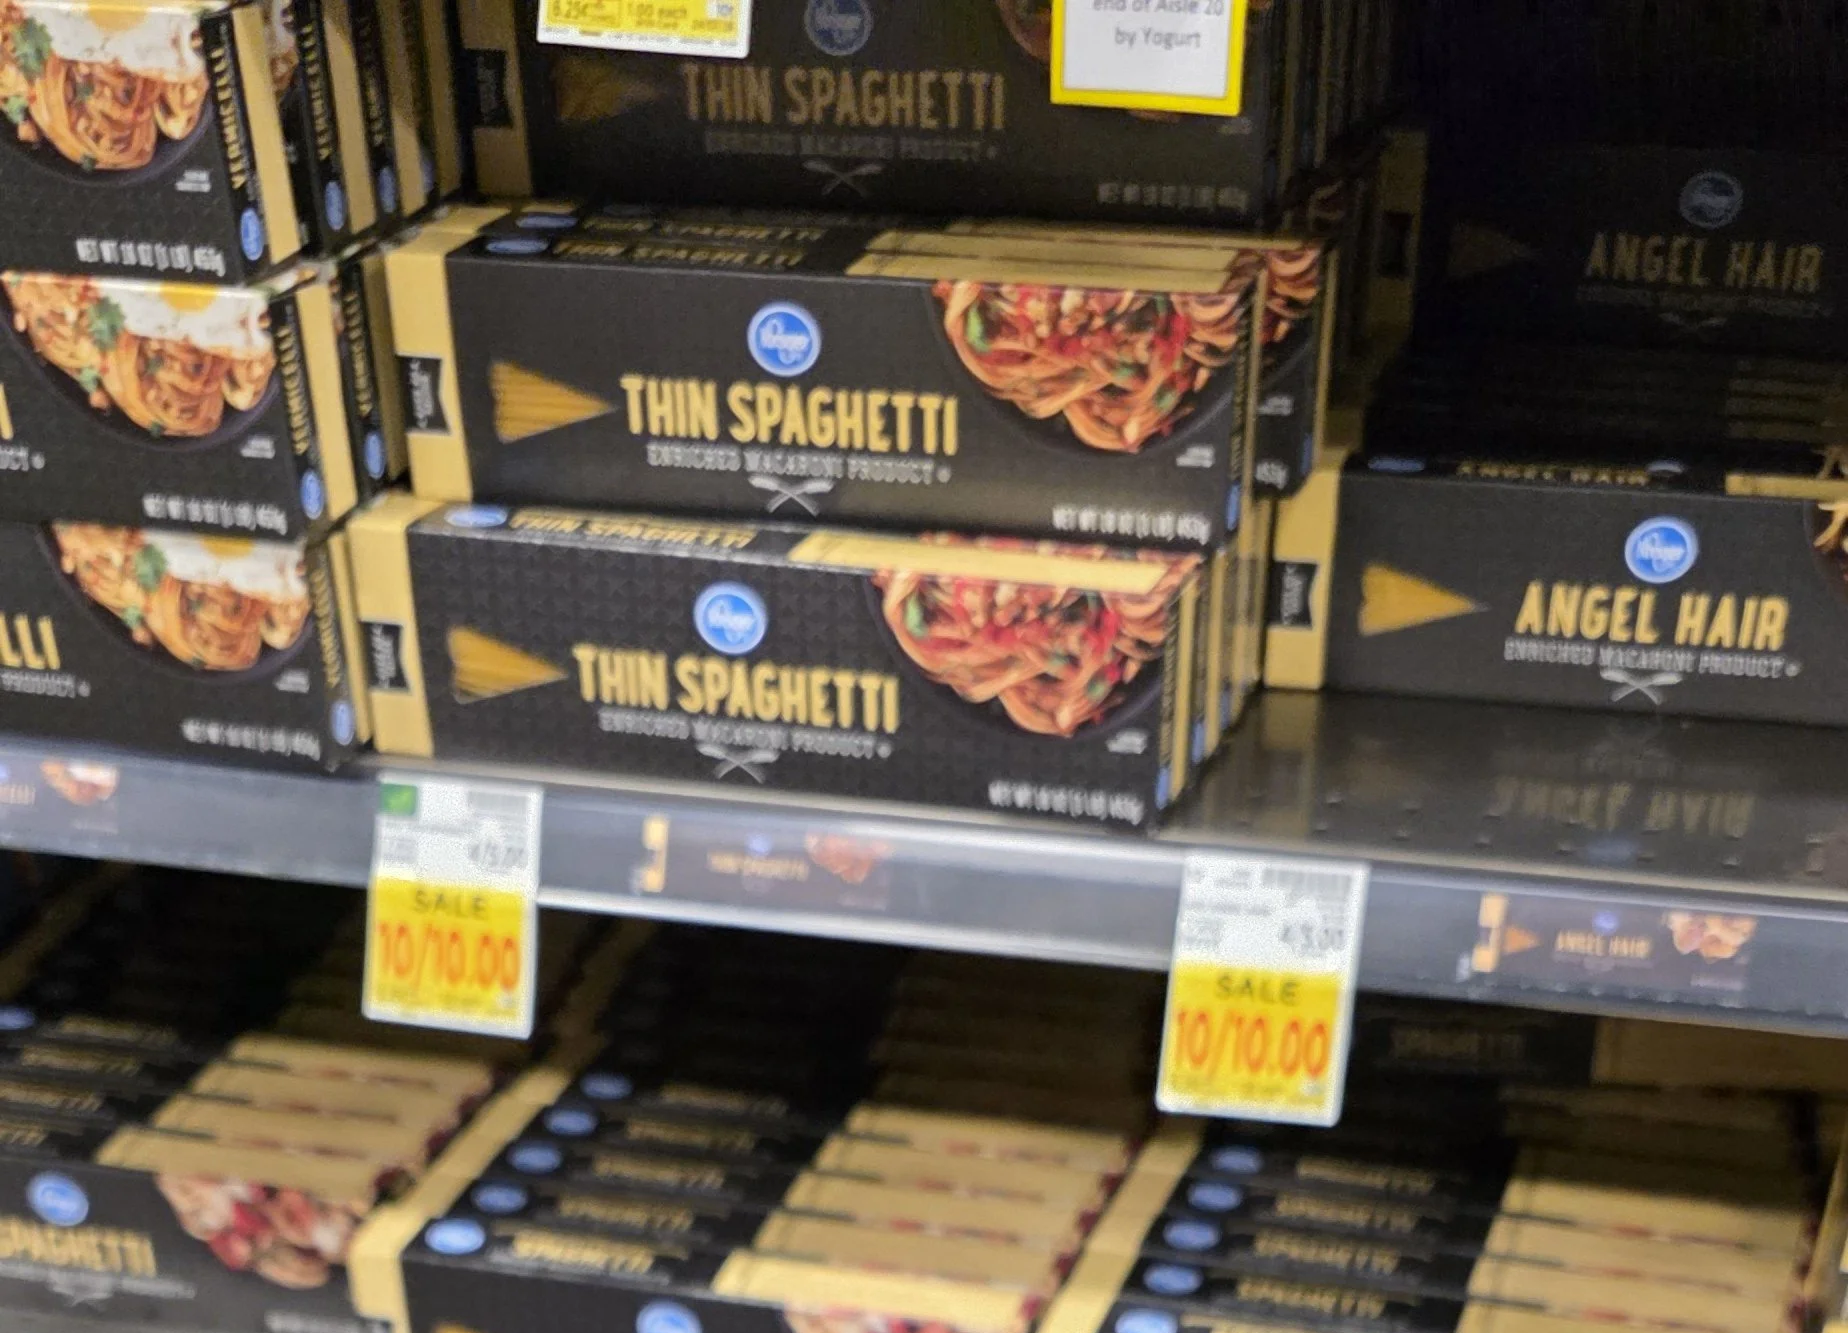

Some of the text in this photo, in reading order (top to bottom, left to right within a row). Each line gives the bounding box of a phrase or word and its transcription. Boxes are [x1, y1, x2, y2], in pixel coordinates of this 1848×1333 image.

[1115, 26, 1202, 50] by Yogurt
[1154, 0, 1199, 13] Aisle
[681, 60, 1005, 132] THIN SPAGHETTI
[1585, 229, 1824, 293] ANGEL HAIR
[620, 373, 959, 457] THIN SPAGHETTI
[1514, 579, 1790, 652] ANGEL HAIR
[572, 642, 899, 734] THIN SPAGHETTI
[413, 888, 489, 922] SALE
[1214, 973, 1301, 1007] SALE
[1174, 1006, 1330, 1082] 10/10.00
